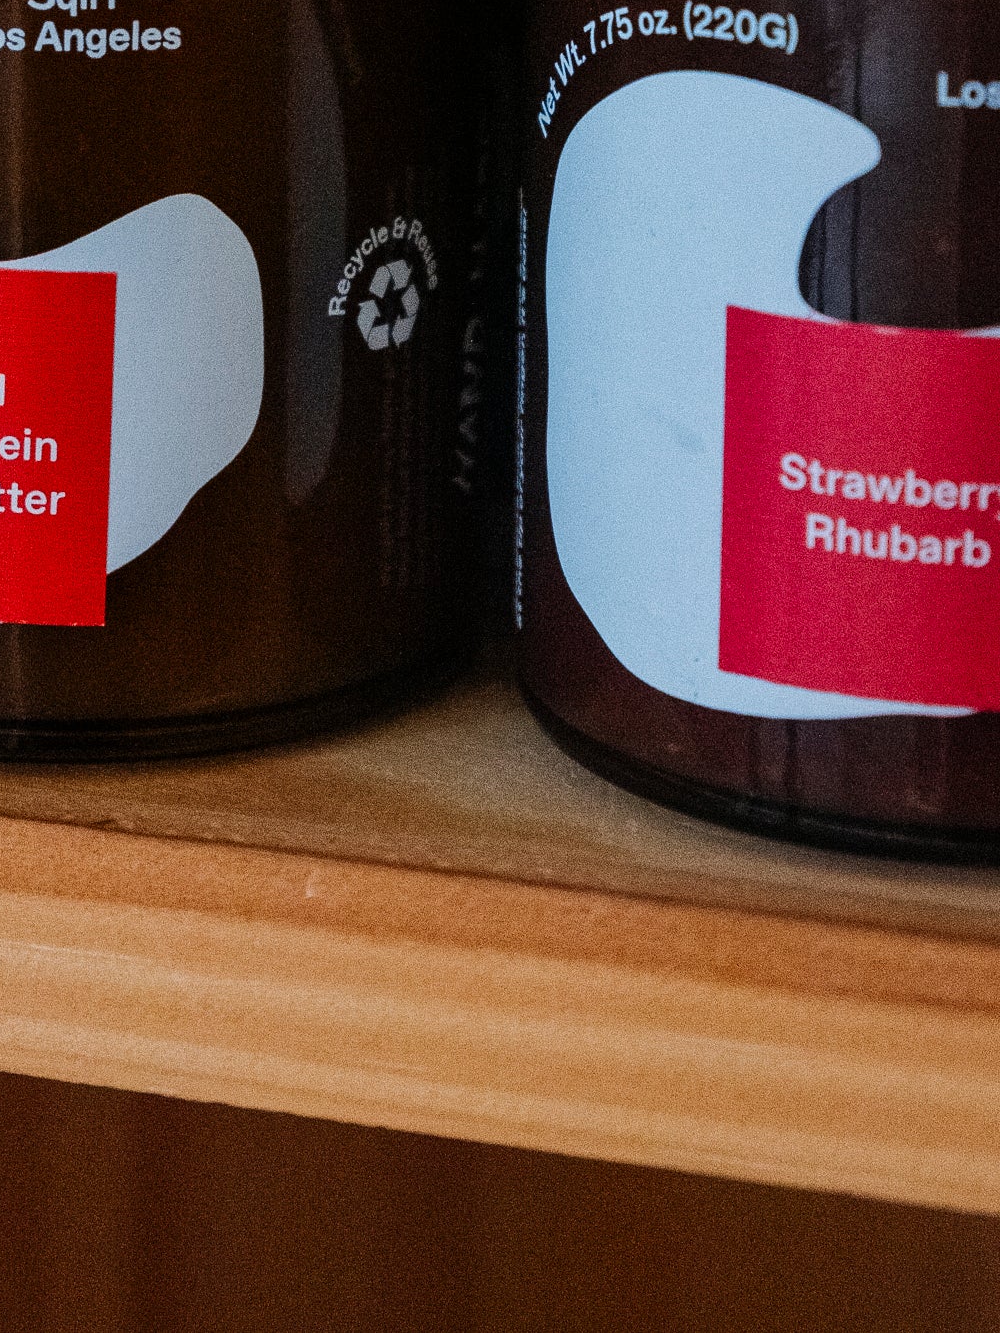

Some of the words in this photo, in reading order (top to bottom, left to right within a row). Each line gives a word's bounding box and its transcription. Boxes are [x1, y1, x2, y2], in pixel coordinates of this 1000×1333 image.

[33, 19, 183, 59] Angeles
[537, 74, 561, 138] Net
[554, 43, 587, 87] Wt.
[583, 7, 634, 56] 7.75
[638, 8, 678, 36] oz.
[683, 0, 800, 56] (220G)
[329, 226, 389, 317] Recycle
[392, 216, 408, 239] &
[408, 219, 438, 291] Reuse
[778, 451, 1000, 520] Strawberr
[804, 512, 992, 568] Rhubarb
